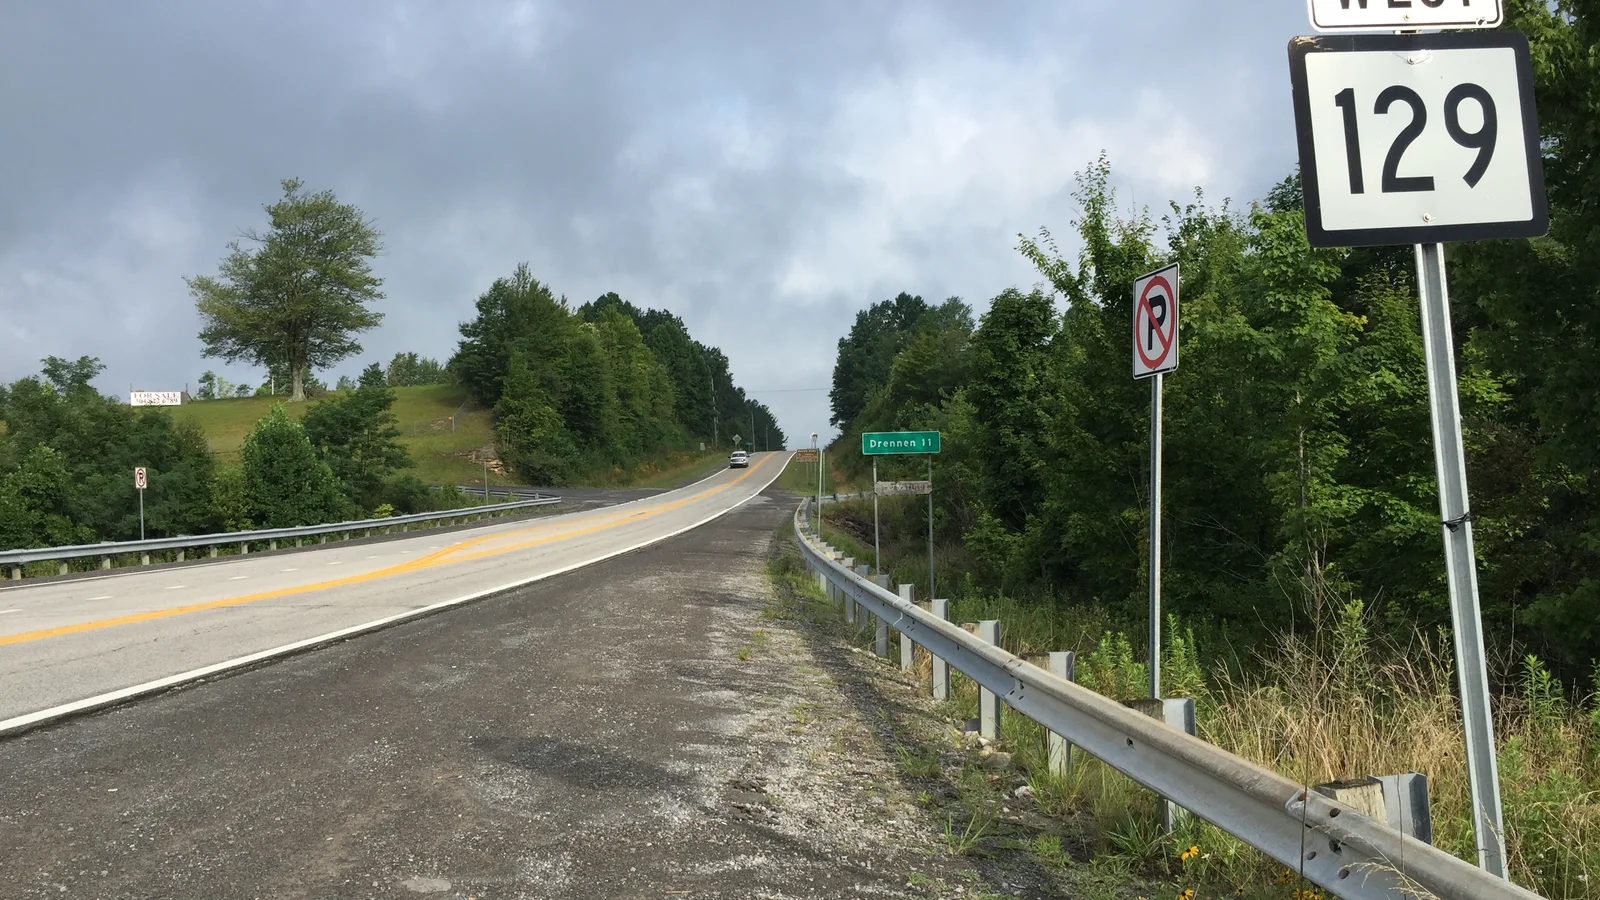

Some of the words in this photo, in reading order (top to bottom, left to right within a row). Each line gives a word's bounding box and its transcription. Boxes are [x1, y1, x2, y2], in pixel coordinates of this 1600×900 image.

[1334, 82, 1498, 194] 129
[1148, 294, 1166, 351] P
[869, 439, 916, 448] Drennen
[921, 438, 932, 447] 11
